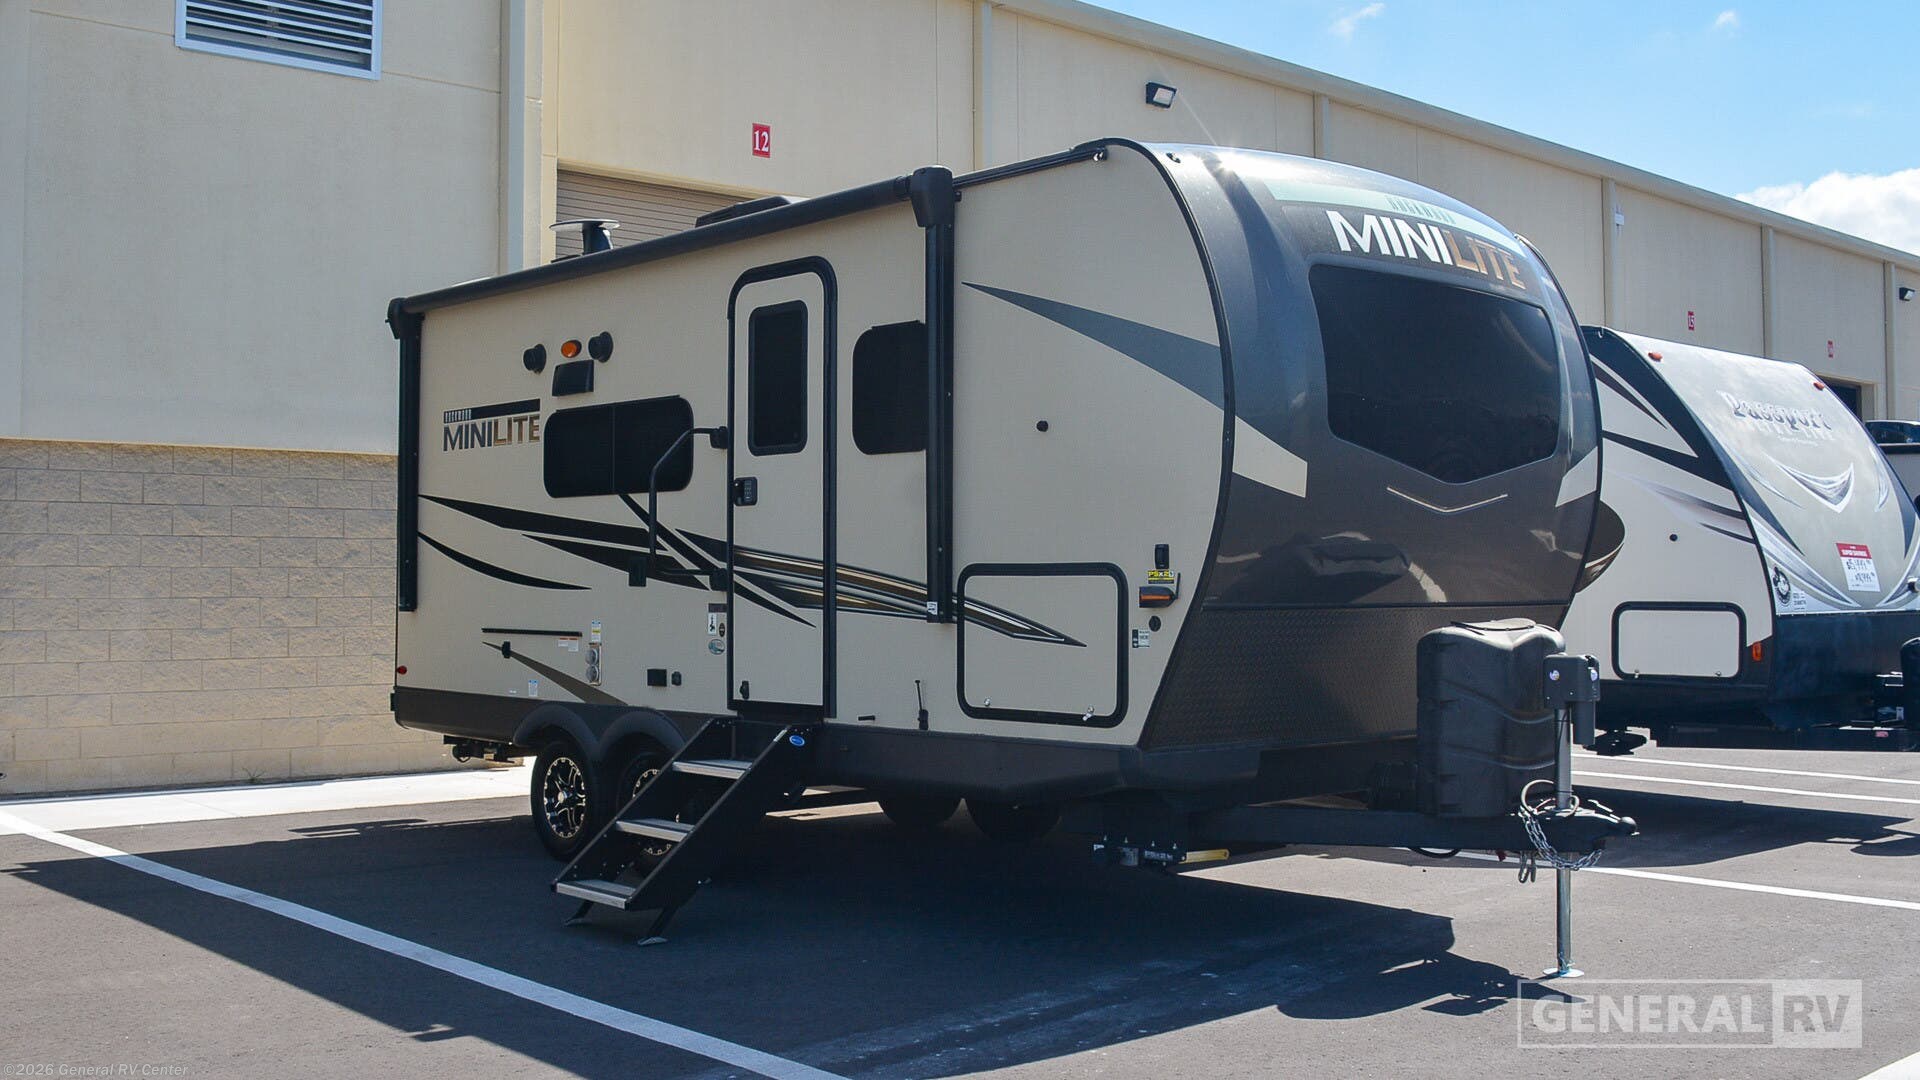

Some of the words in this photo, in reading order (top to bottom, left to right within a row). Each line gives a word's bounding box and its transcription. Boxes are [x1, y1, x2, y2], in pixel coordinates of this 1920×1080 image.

[754, 129, 769, 152] 12
[1325, 210, 1526, 290] MINILITE
[443, 415, 540, 451] MINILITE
